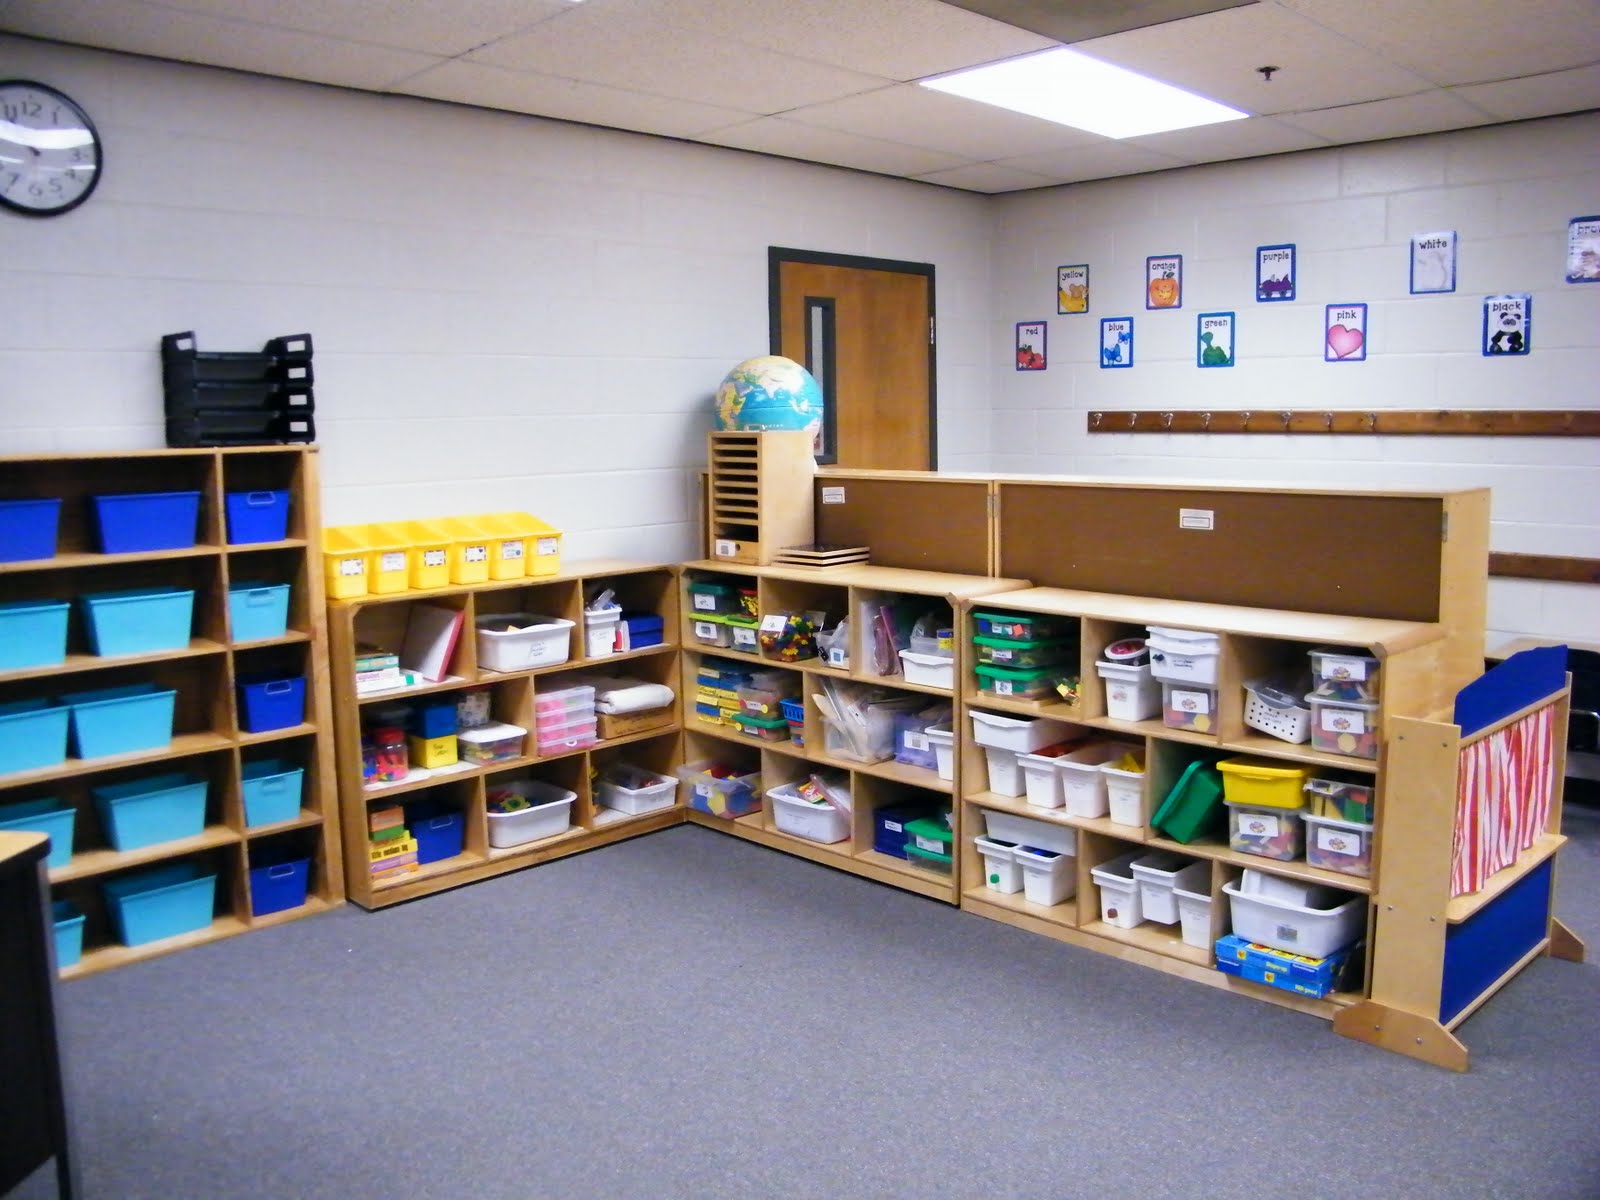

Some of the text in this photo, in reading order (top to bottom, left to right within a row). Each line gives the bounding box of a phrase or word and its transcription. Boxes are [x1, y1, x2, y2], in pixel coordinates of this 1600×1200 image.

[21, 101, 42, 117] 12
[1577, 223, 1600, 235] bro
[1419, 239, 1447, 250] white
[1262, 250, 1290, 263] purple
[1151, 262, 1176, 272] orange
[1061, 271, 1084, 280] yellow
[1492, 301, 1521, 312] black
[1336, 310, 1357, 321] pink
[1108, 323, 1124, 331] blue
[1204, 319, 1228, 328] green
[1025, 327, 1039, 335] red
